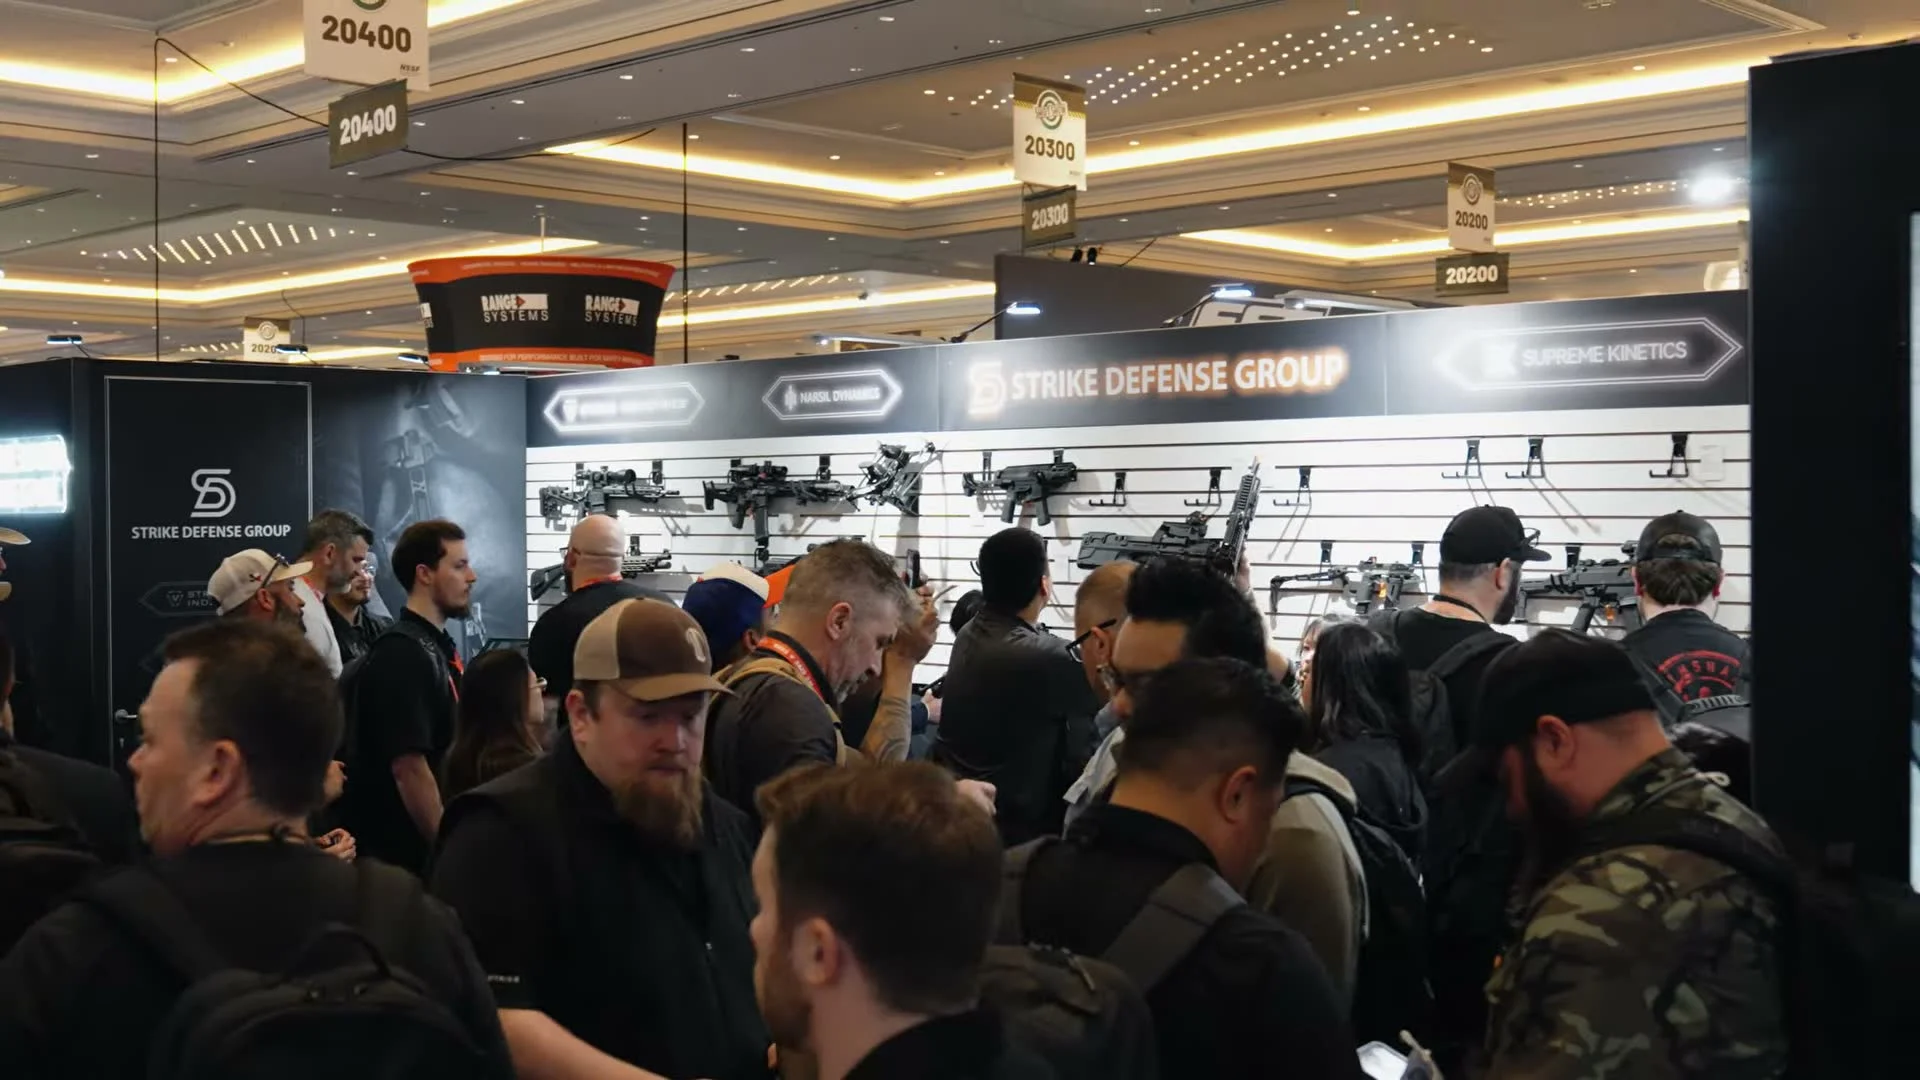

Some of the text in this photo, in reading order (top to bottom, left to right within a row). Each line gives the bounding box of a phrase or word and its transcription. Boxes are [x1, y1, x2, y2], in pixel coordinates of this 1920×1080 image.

[322, 15, 411, 53] 20400
[340, 104, 396, 145] 20400
[1025, 135, 1075, 161] 20300
[1032, 203, 1069, 231] 20300
[1455, 210, 1488, 230] 20200
[1446, 265, 1498, 285] 20200
[481, 294, 519, 312] RANGE
[585, 295, 621, 313] RANGE
[484, 310, 549, 323] SYSTEMS
[585, 311, 637, 327] SYSTEMS
[1522, 341, 1687, 367] SUPREME KINETICS
[1012, 366, 1098, 400] STRIKE
[1105, 360, 1228, 396] DEFENSE
[1234, 354, 1345, 389] GROUP
[800, 389, 832, 404] NARSIL
[131, 524, 292, 539] STRIKE DEFENSE GROUP
